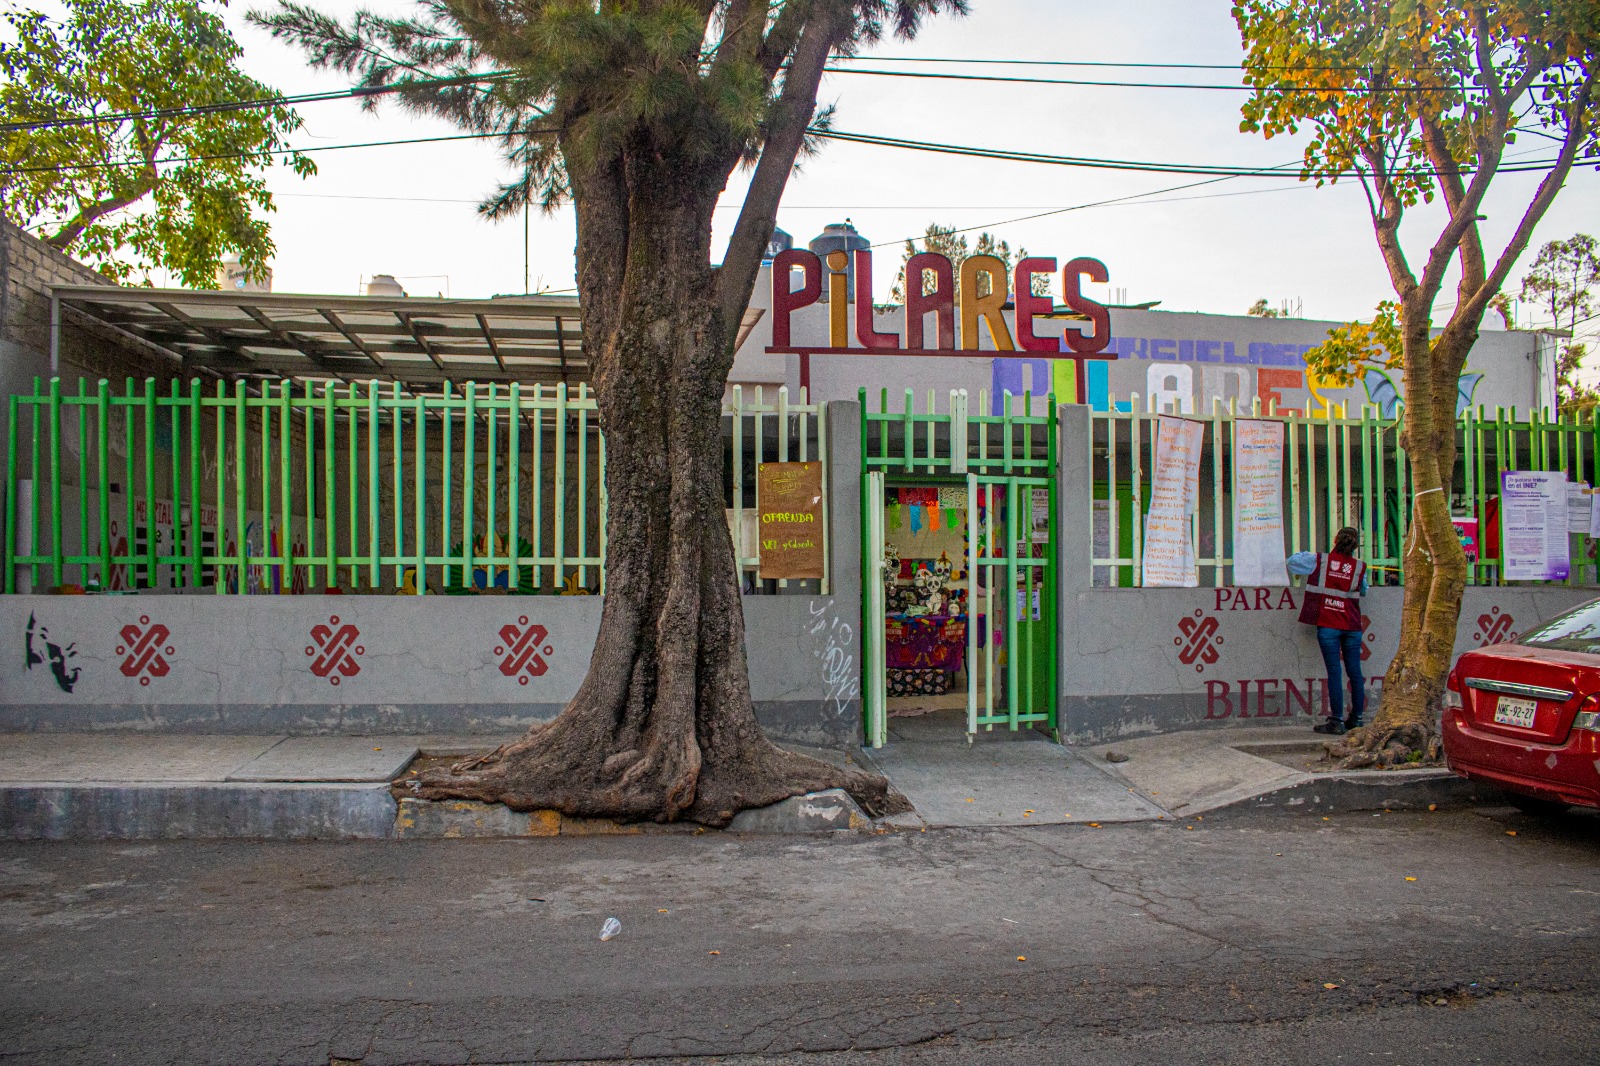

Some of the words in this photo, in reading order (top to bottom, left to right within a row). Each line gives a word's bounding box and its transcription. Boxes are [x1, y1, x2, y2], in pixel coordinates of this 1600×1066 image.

[992, 357, 1346, 418] PILARES
[762, 512, 815, 524] OFRENDA
[1214, 587, 1297, 611] PARA
